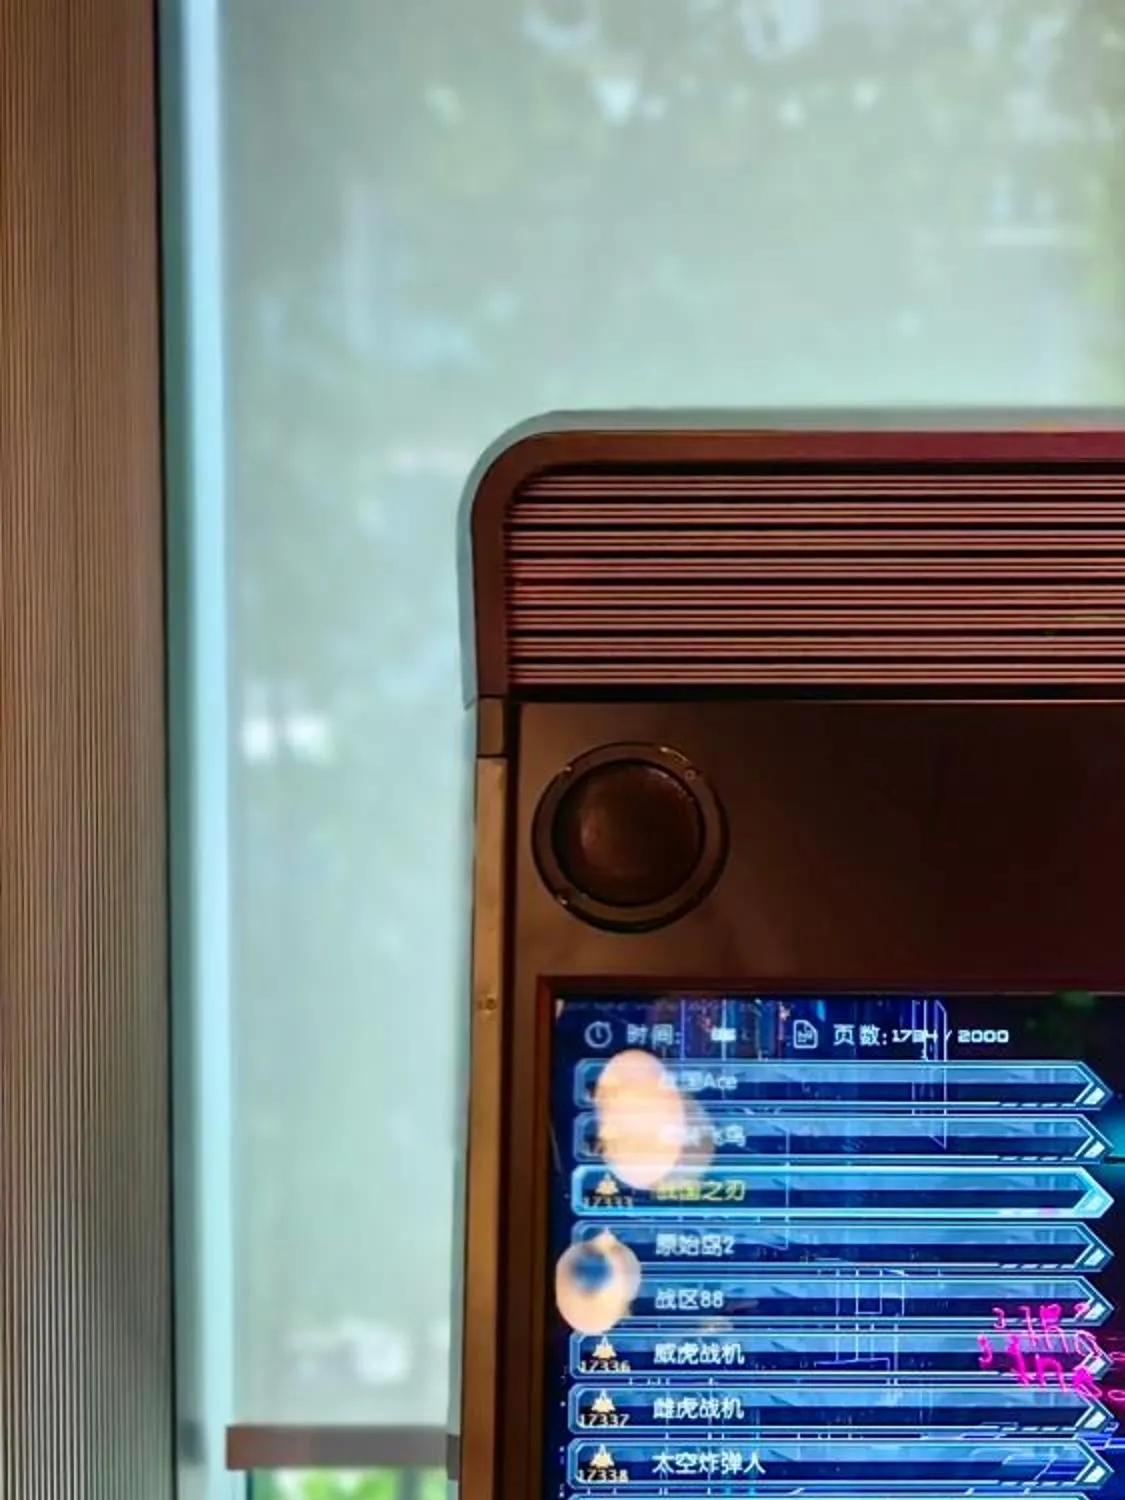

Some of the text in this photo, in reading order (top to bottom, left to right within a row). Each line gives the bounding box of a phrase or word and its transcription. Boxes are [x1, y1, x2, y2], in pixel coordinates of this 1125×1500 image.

[957, 1029, 1009, 1043] 2000
[651, 1451, 767, 1476] 太空炸弹人
